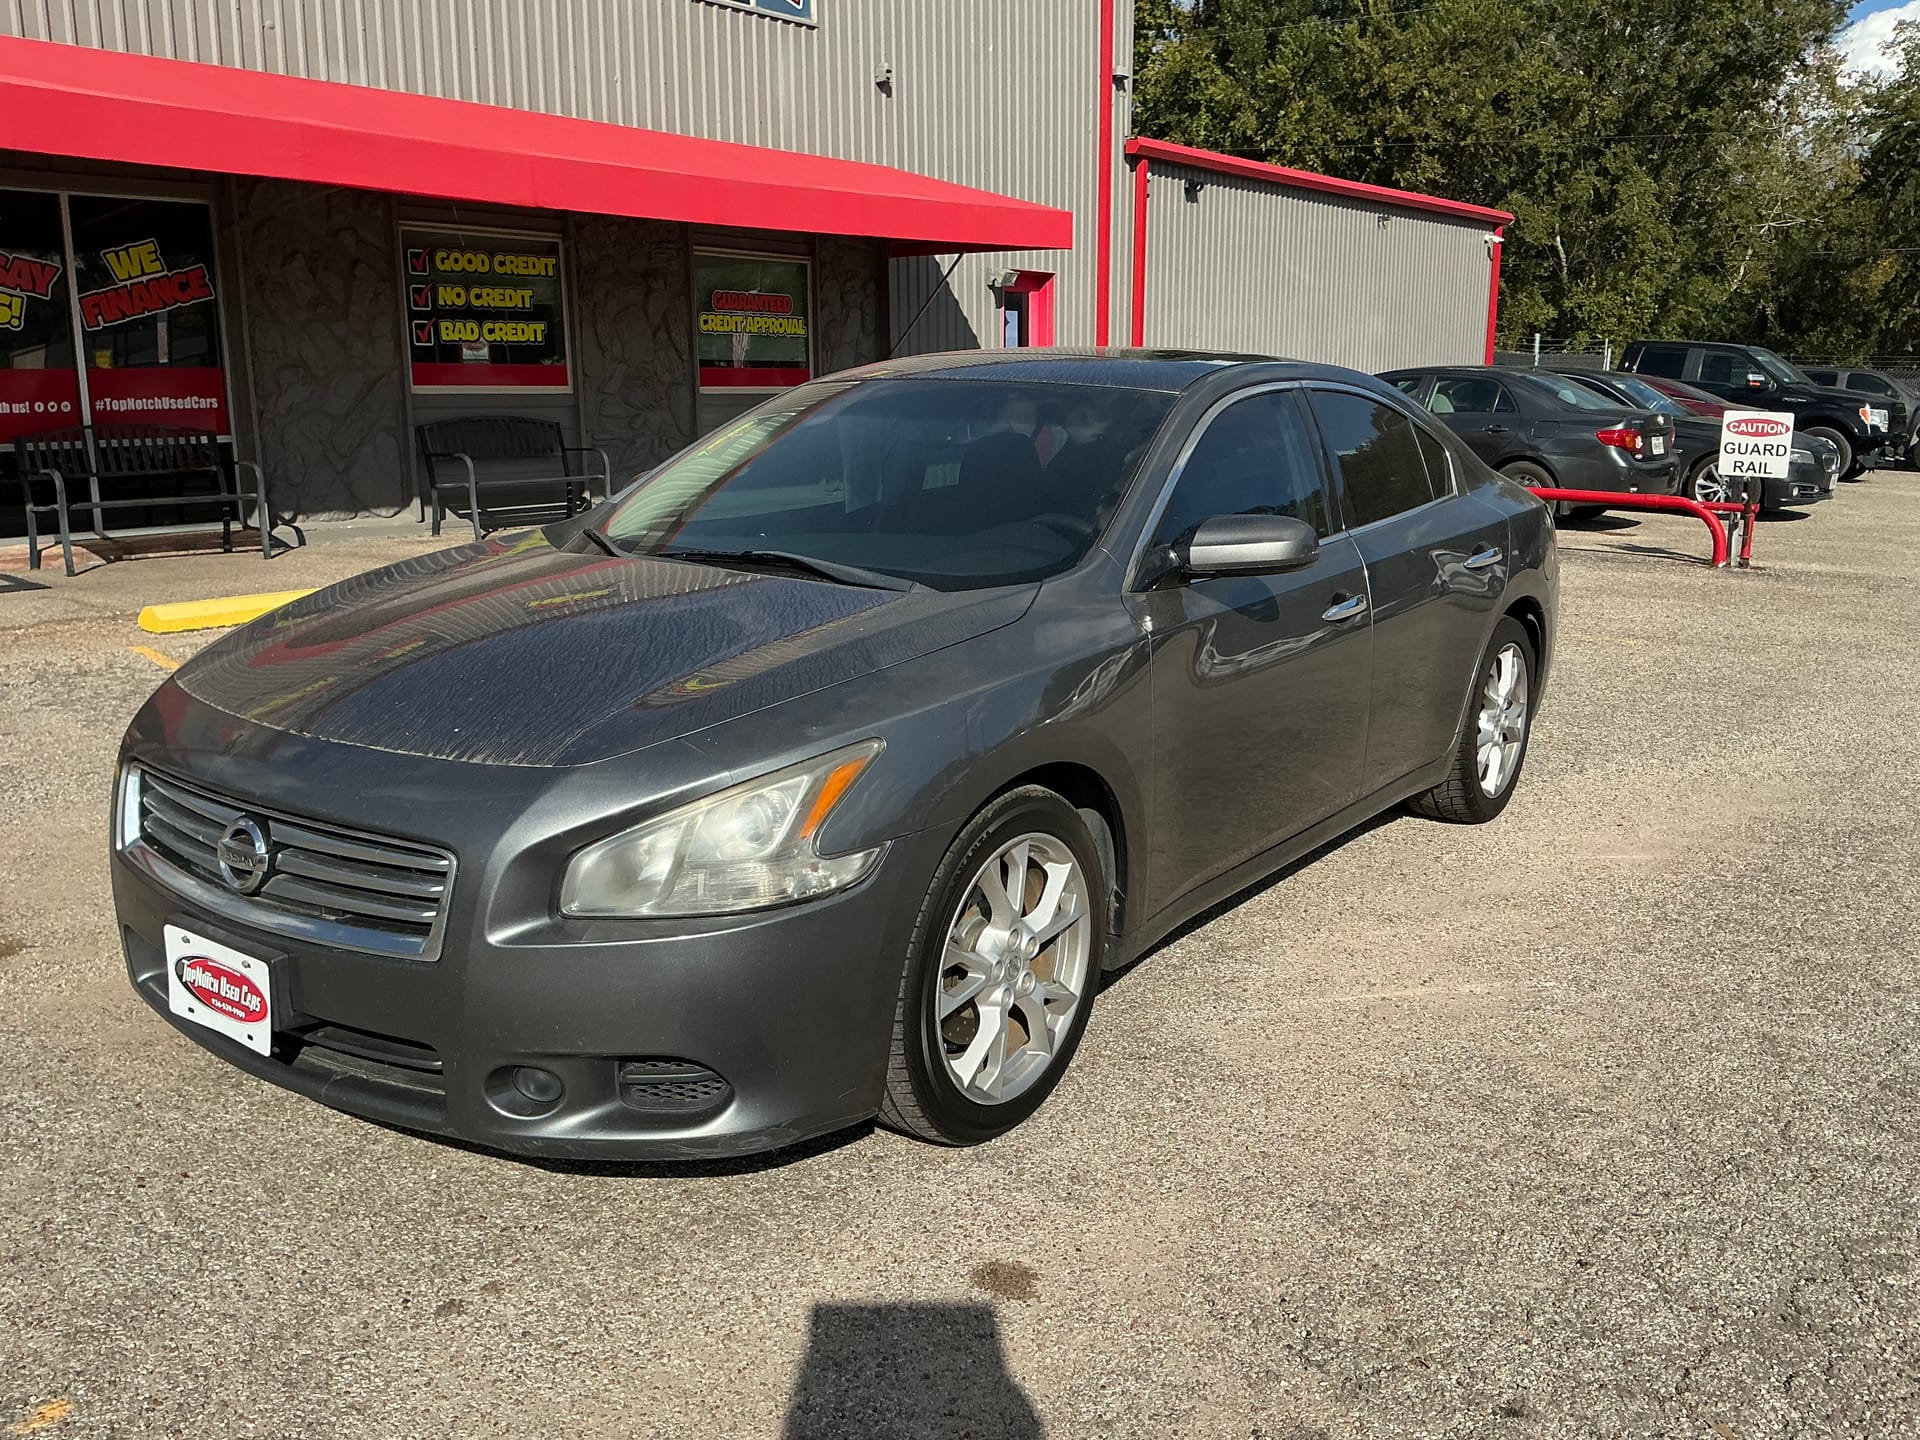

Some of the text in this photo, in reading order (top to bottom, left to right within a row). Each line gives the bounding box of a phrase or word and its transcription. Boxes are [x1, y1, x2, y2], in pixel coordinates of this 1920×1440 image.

[106, 244, 163, 280] WE
[435, 251, 556, 277] GOOD CREDIT
[80, 265, 211, 328] FINANCE
[438, 286, 533, 308] NO CREDIT
[713, 292, 791, 313] GUARANTEED
[440, 321, 545, 342] BAD CREDIT
[700, 314, 806, 334] CREDIT APPROVAL
[95, 396, 218, 411] #TopNotchUsedCars
[1729, 422, 1787, 434] CAUTION
[1724, 441, 1787, 457] GUARD
[1733, 460, 1773, 474] RAIL
